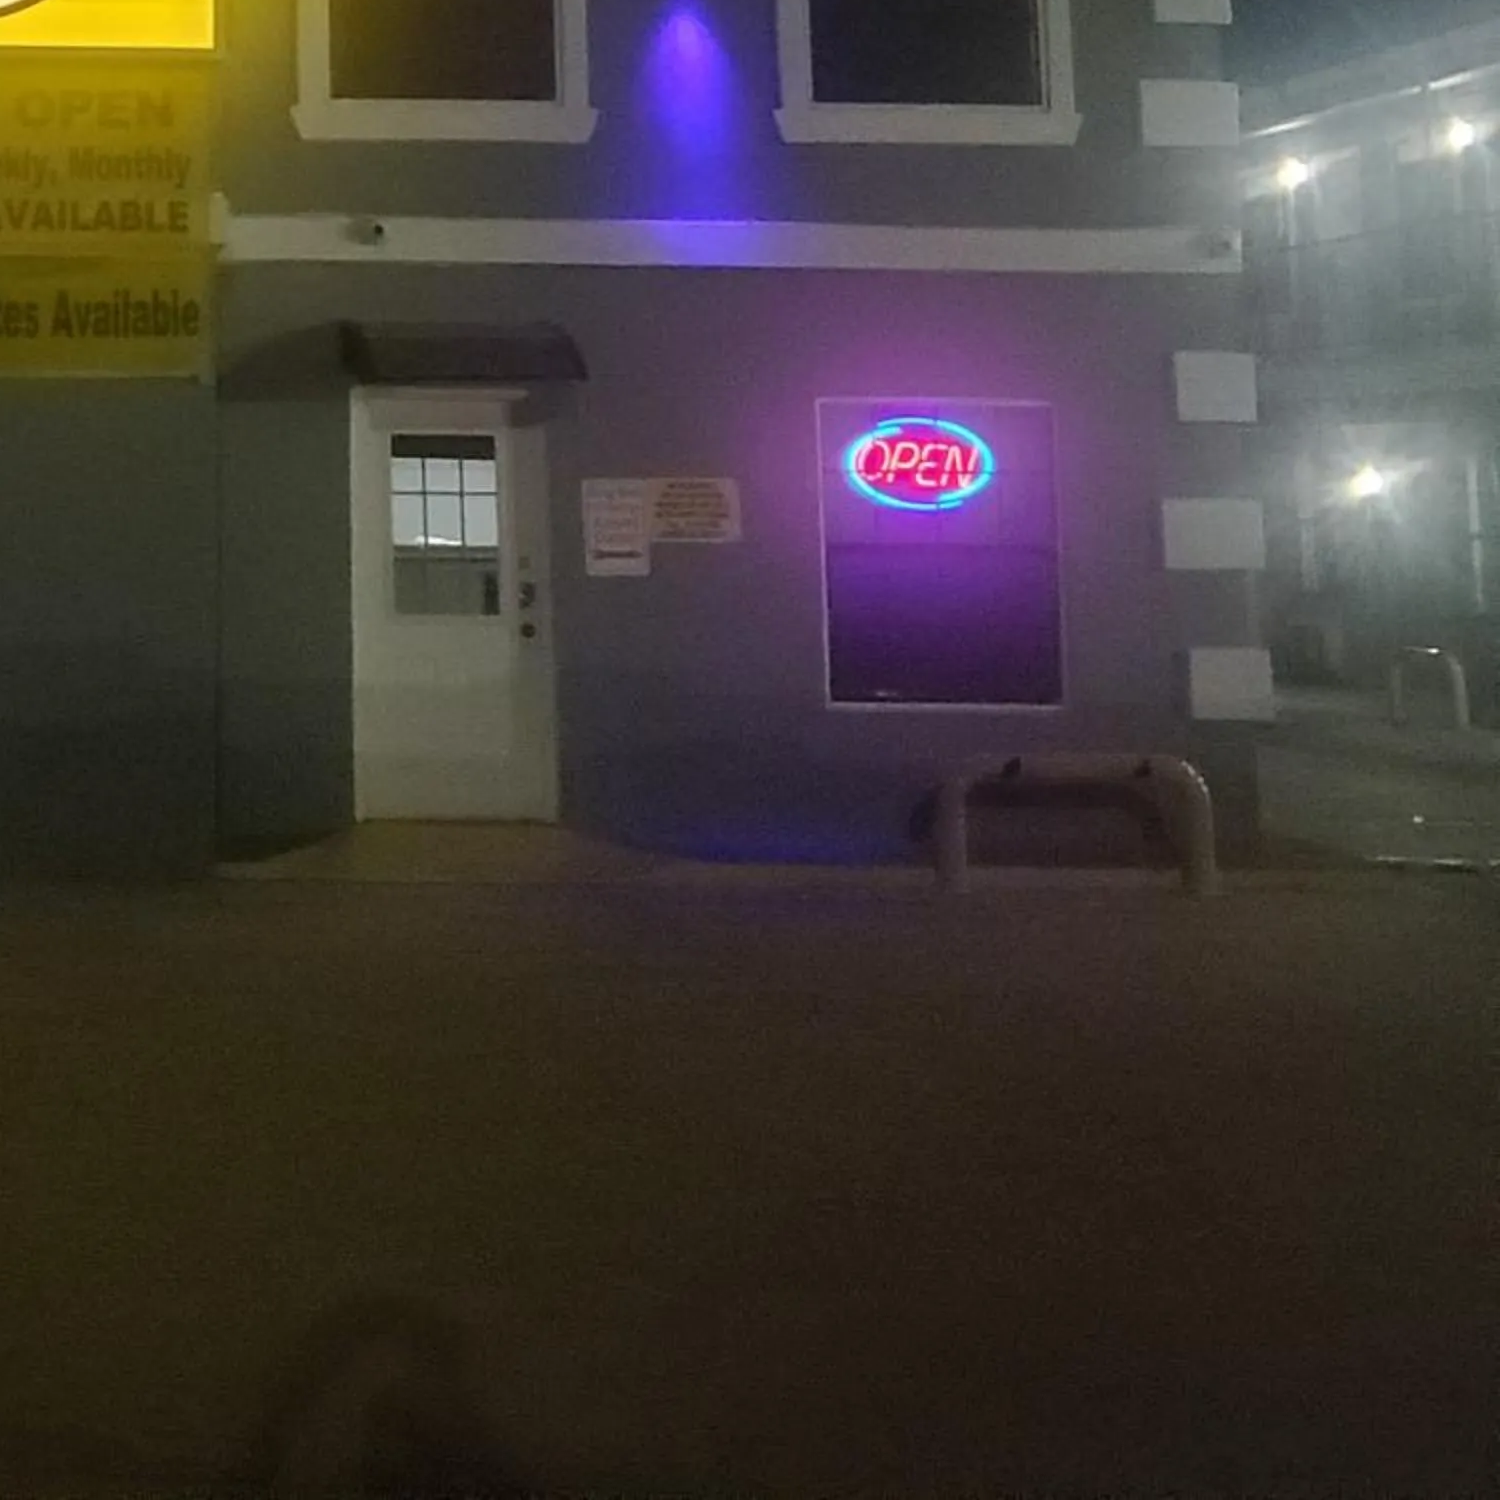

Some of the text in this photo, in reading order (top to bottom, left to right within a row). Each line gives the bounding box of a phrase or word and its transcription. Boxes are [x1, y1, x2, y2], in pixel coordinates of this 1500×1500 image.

[15, 88, 176, 129] OPEN
[68, 145, 192, 188] Monthly
[50, 288, 202, 339] Available
[857, 438, 981, 490] OPEN
